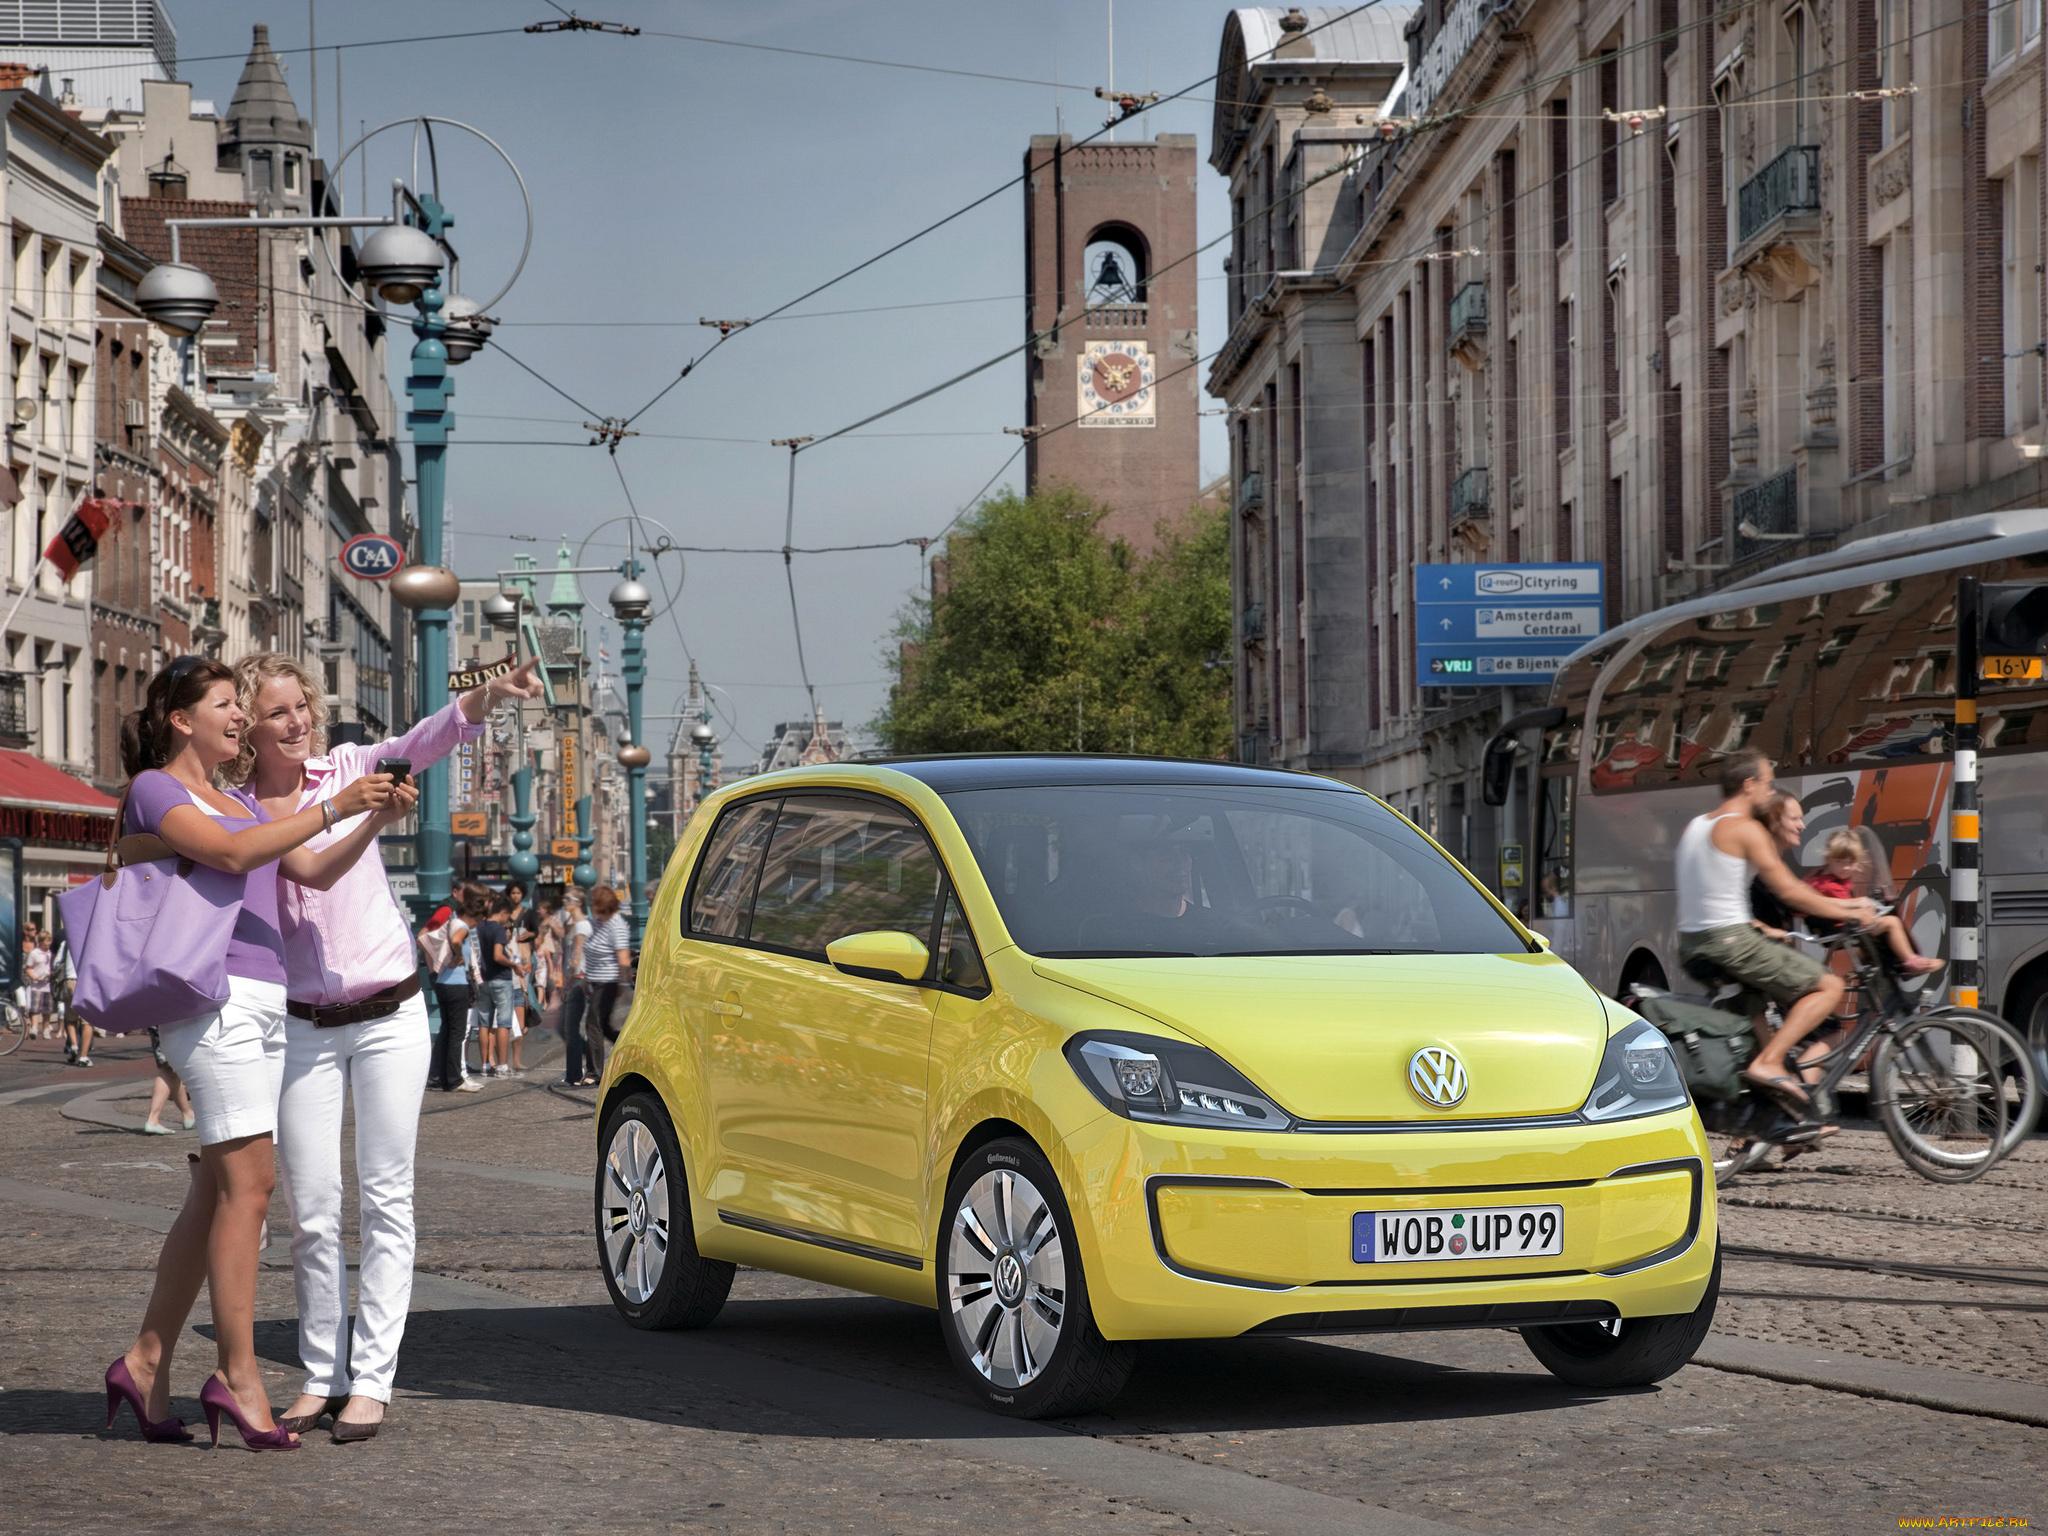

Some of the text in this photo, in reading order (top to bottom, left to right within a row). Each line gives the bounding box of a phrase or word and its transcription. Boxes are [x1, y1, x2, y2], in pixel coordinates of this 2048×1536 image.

[351, 546, 393, 567] C&A
[1524, 576, 1578, 590] Cityring
[1495, 610, 1573, 621] Amsterdam
[1523, 624, 1581, 635] Centraal
[1444, 660, 1472, 673] VRIJ
[1496, 657, 1561, 674] de Bijenk
[1995, 659, 2031, 675] 16-V
[448, 663, 510, 688] ASINO
[463, 746, 471, 802] HOTEL
[399, 881, 419, 889] CHE
[1381, 1217, 1445, 1256] WOB
[1472, 1214, 1513, 1252] UP
[1518, 1211, 1557, 1250] 99
